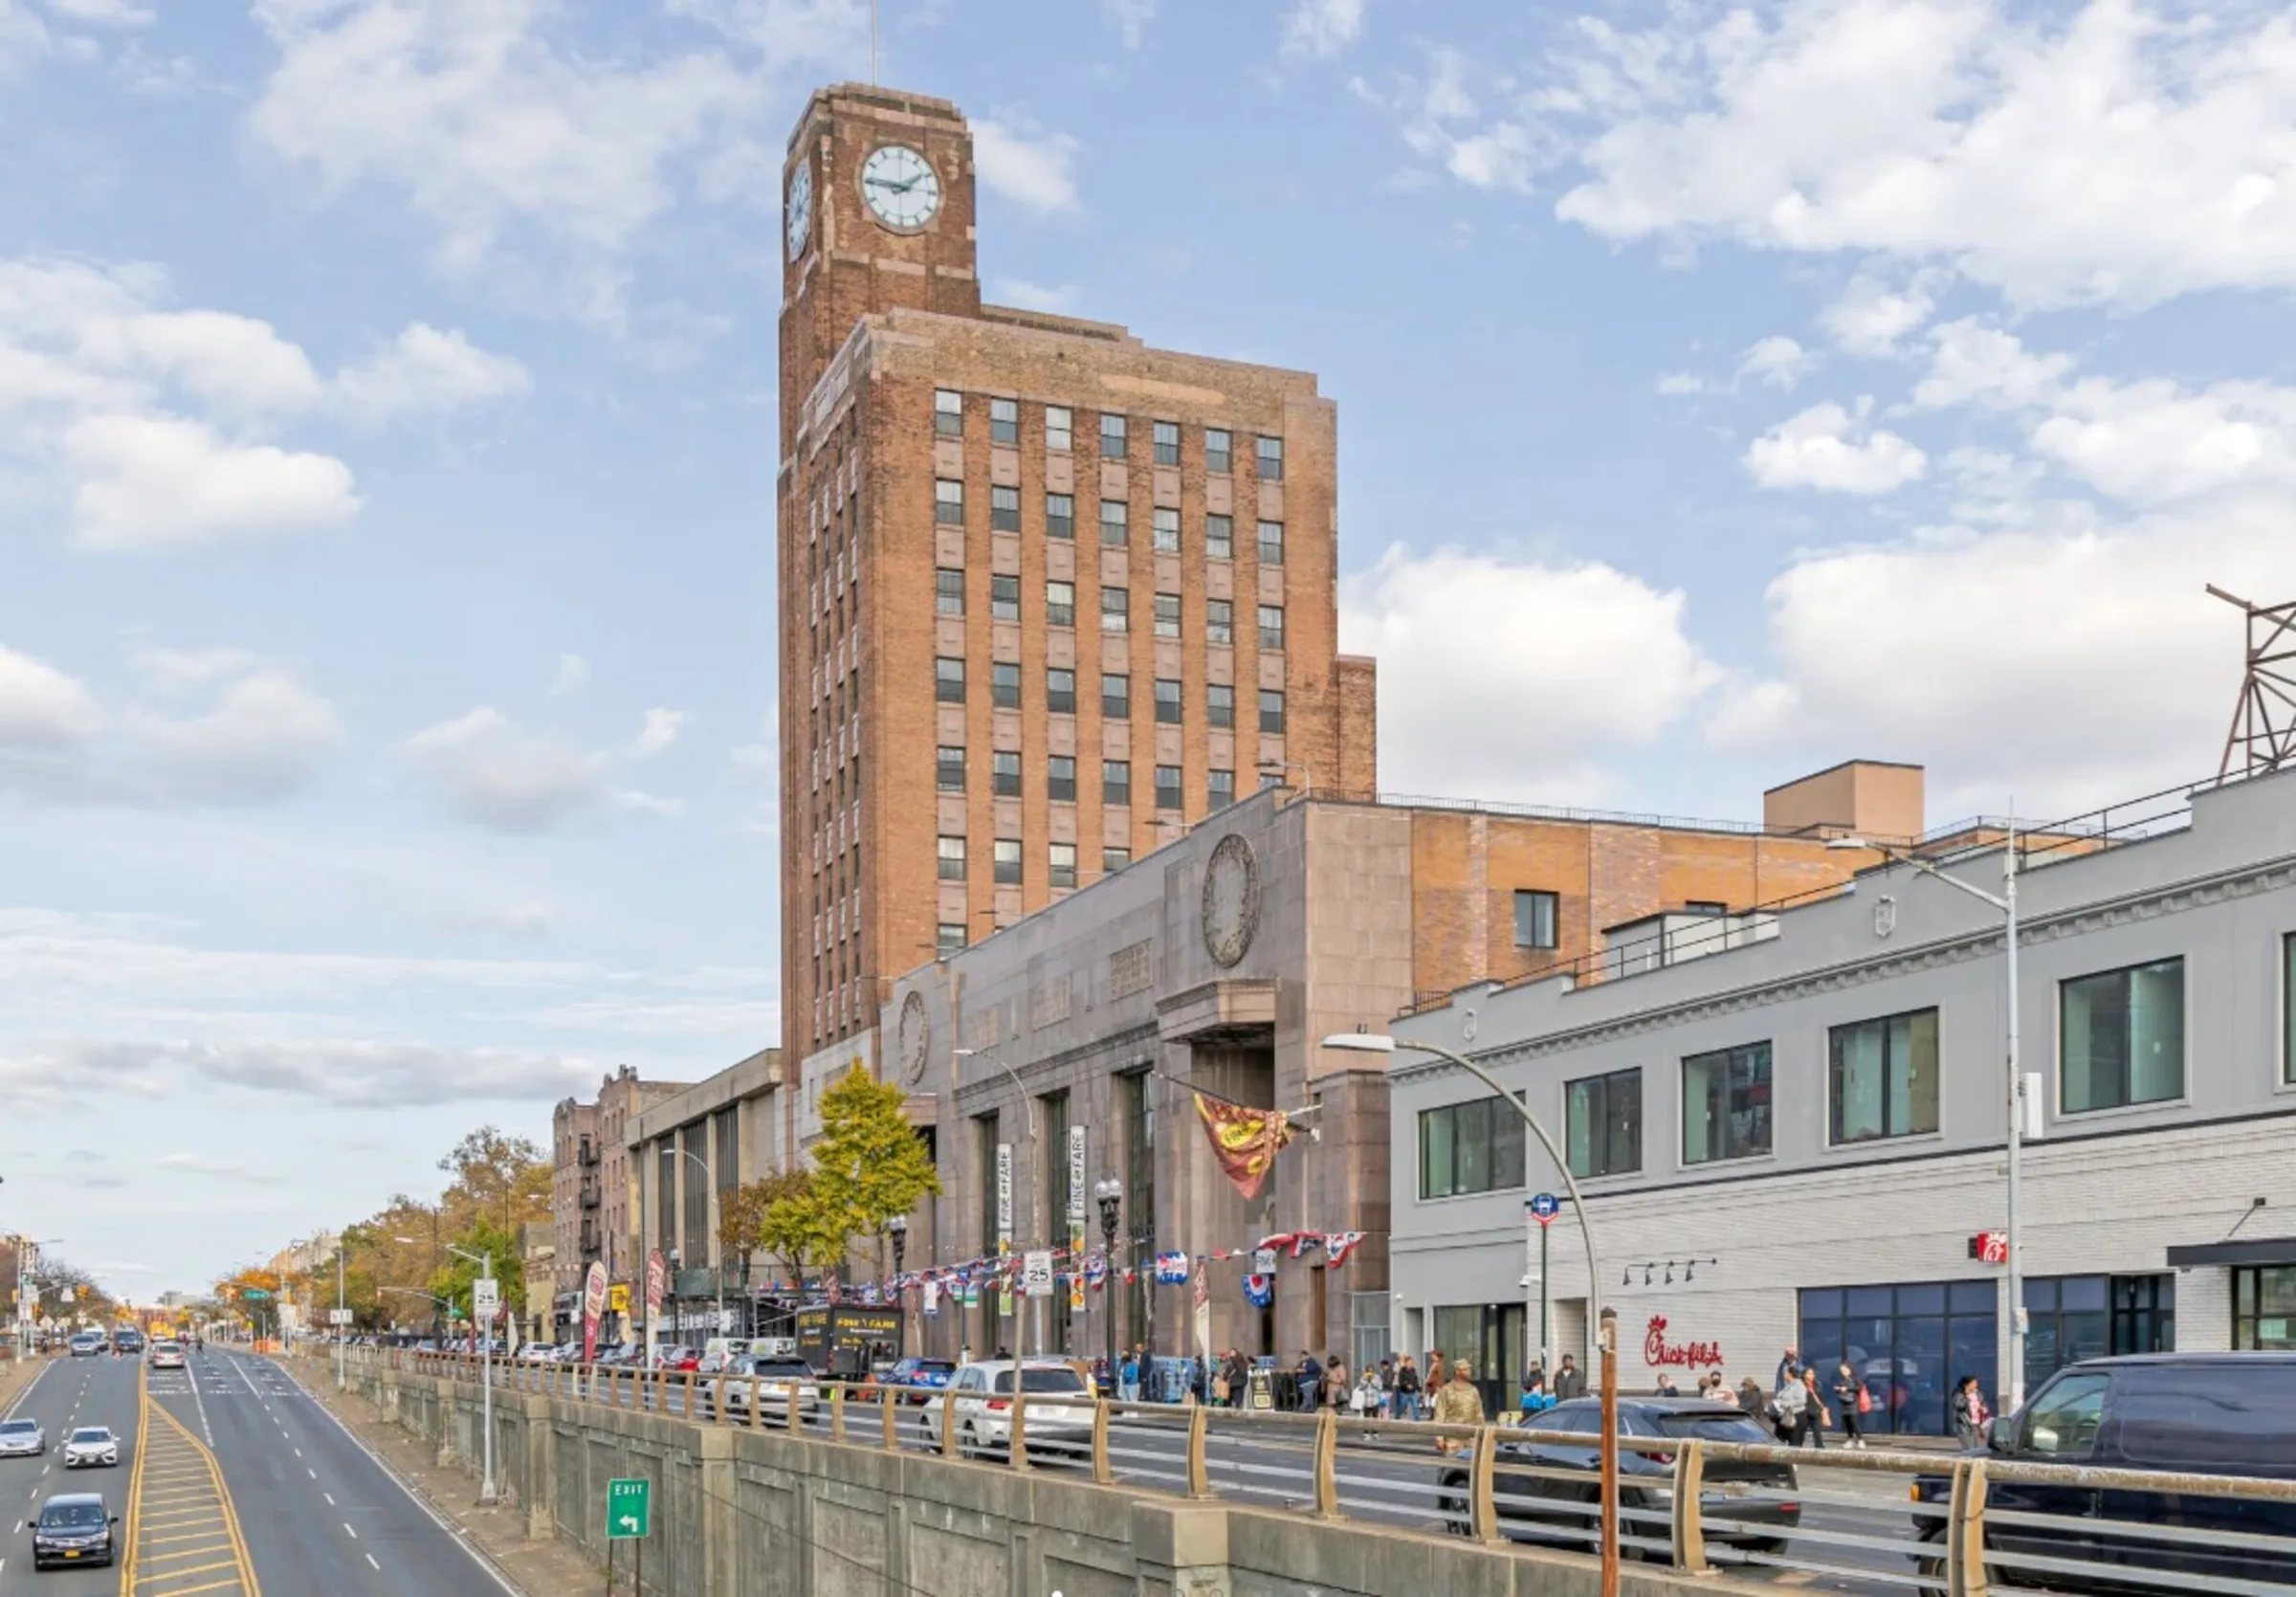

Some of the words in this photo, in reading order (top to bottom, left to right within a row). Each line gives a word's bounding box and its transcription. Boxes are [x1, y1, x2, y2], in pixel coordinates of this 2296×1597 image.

[1072, 1133, 1084, 1167] FARE
[998, 1151, 1010, 1184] FARE
[1072, 1182, 1084, 1210] FINE
[1028, 1268, 1049, 1282] 25
[615, 1484, 643, 1496] EXIT
